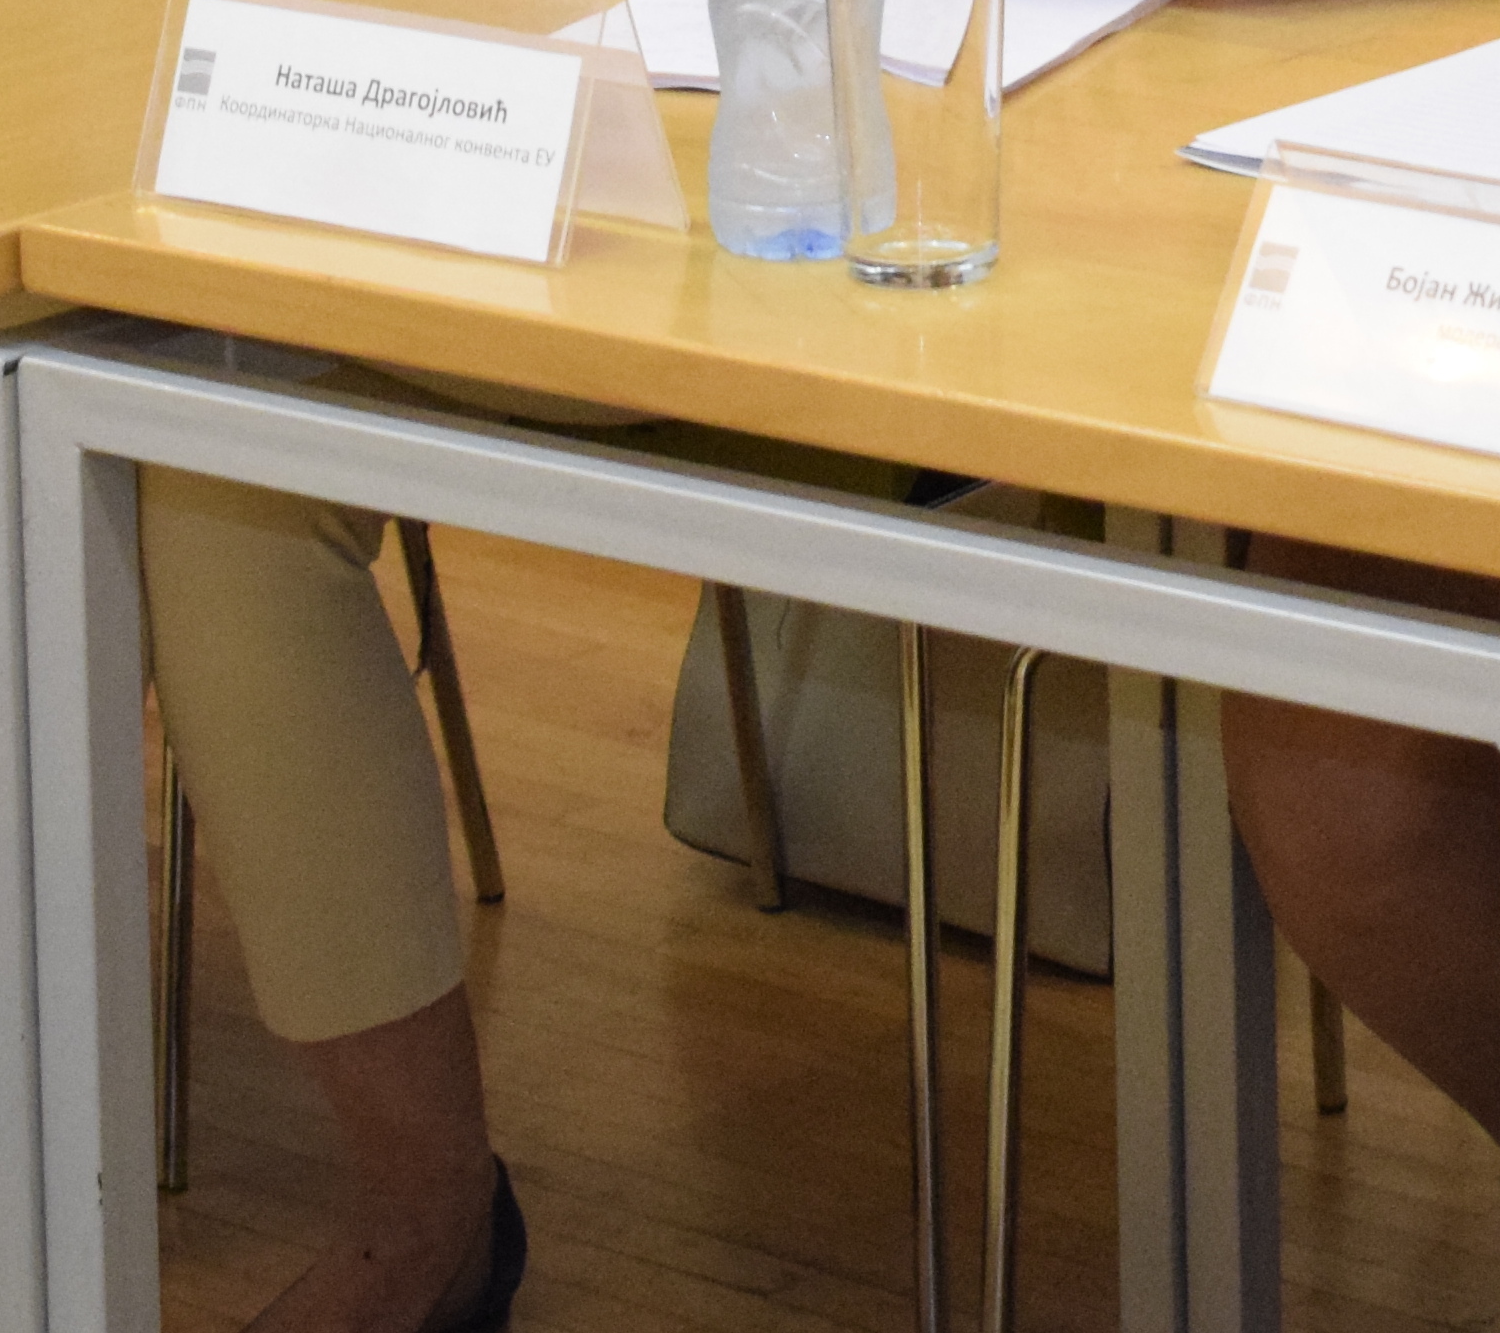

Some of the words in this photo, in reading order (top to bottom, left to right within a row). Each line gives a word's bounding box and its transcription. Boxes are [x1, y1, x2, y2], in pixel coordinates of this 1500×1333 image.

[275, 64, 357, 99] Наташа
[361, 78, 509, 125] Драгојловић
[219, 94, 340, 132] Координаторка
[343, 116, 452, 151] Националног
[453, 136, 531, 164] конвента
[534, 147, 557, 168] ЕУ
[1385, 266, 1458, 302] Бојан
